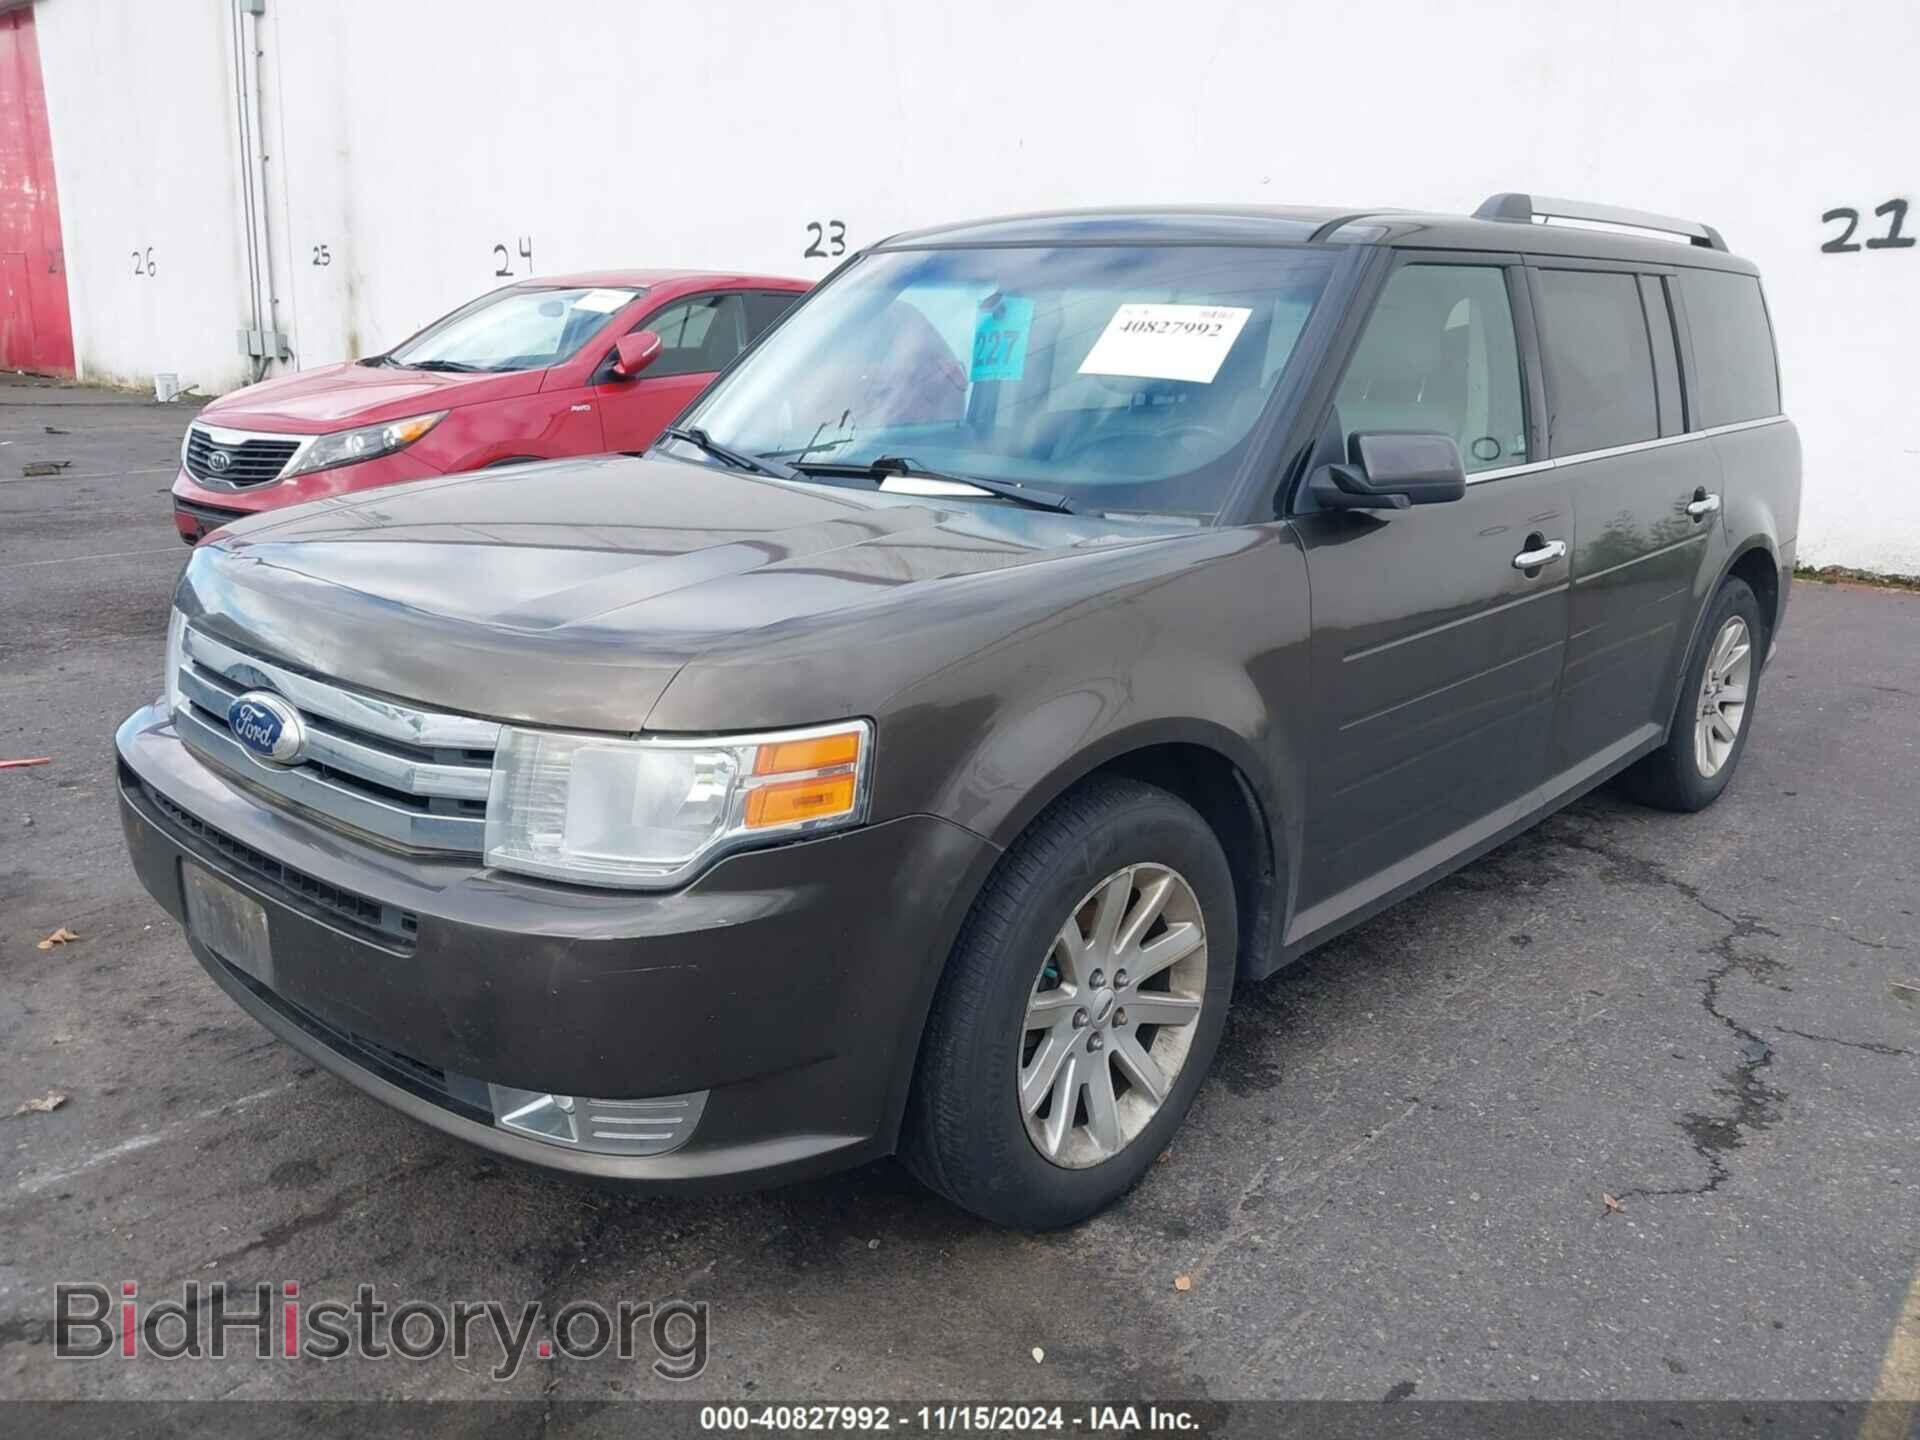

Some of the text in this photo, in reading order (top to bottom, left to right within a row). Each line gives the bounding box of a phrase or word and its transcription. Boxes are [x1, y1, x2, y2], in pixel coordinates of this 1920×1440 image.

[804, 220, 846, 259] 23
[1821, 199, 1916, 252] 21
[132, 247, 157, 278] 26
[312, 245, 331, 266] 25
[493, 236, 532, 277] 24
[1120, 319, 1223, 337] 40827992
[975, 330, 1020, 367] 227
[235, 704, 275, 747] Ford
